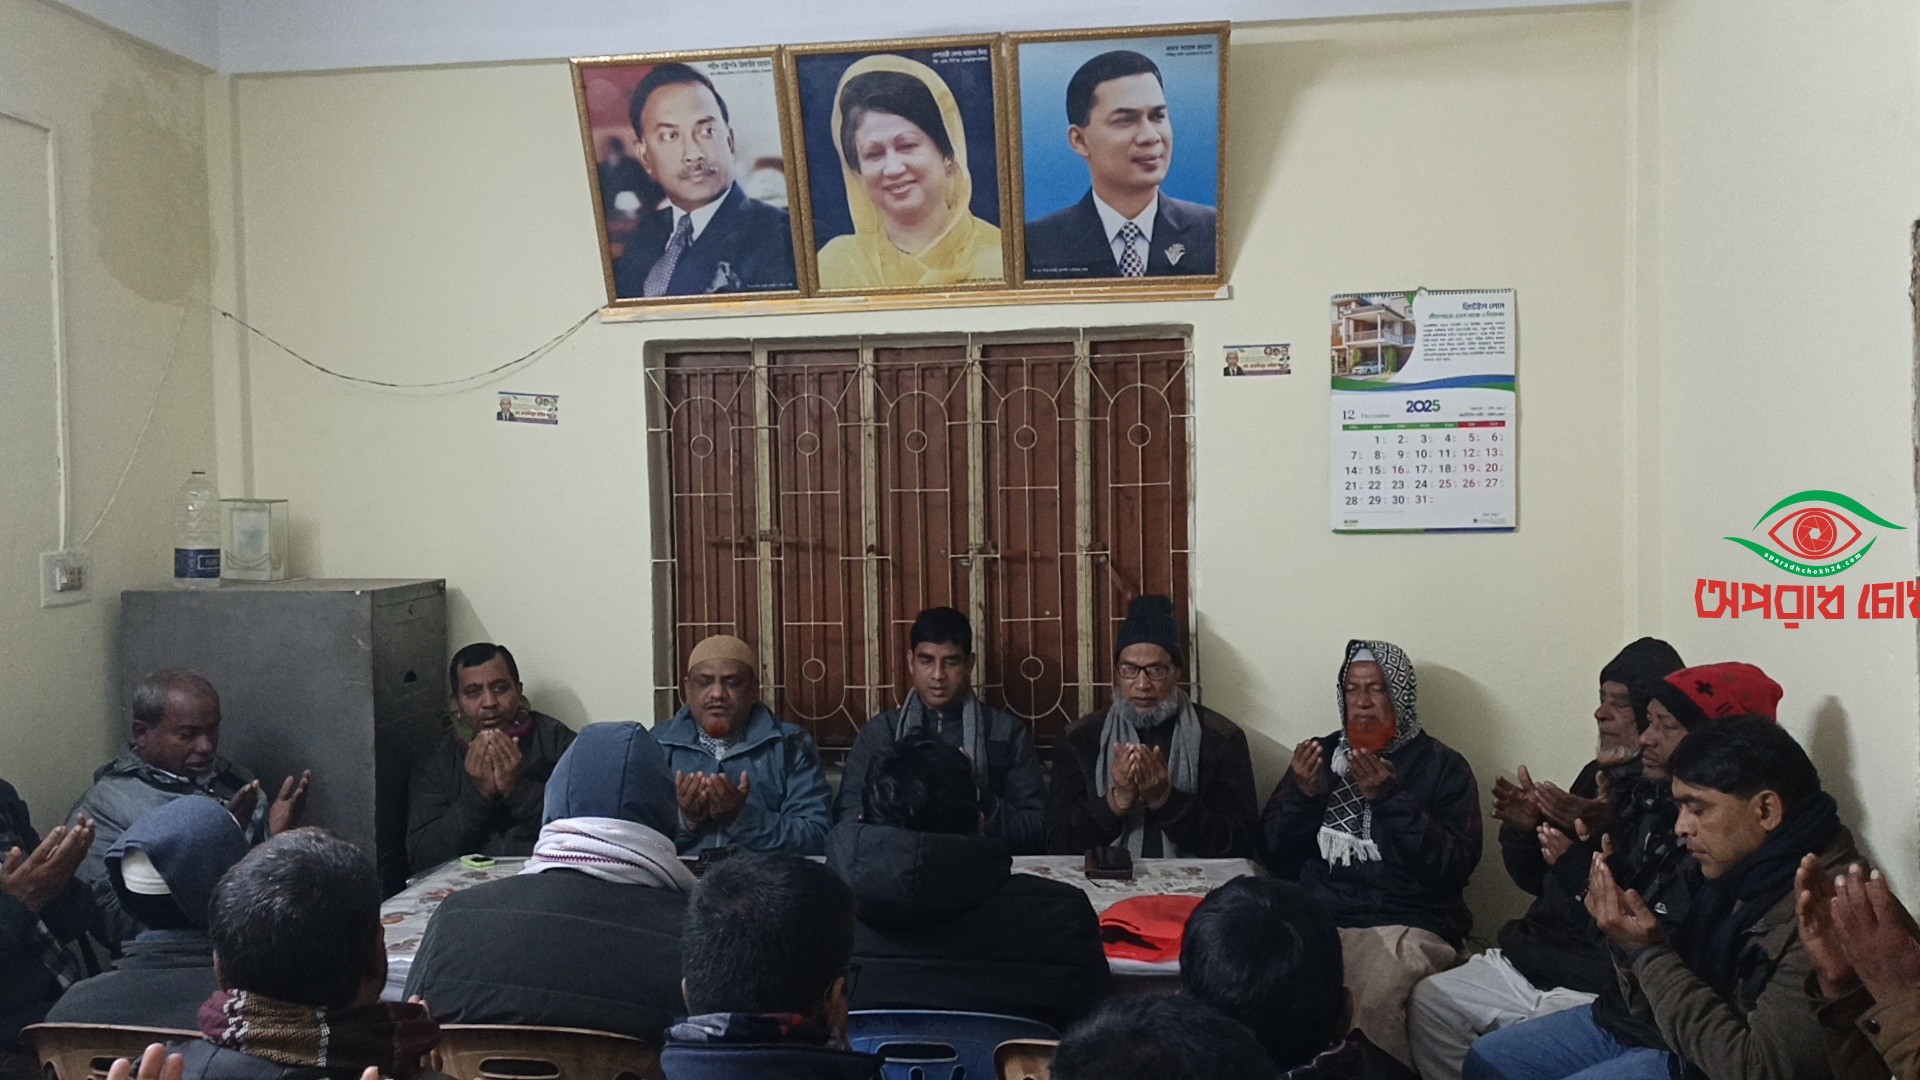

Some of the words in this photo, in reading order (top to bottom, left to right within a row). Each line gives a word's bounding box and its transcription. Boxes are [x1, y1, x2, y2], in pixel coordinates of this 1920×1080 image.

[1406, 400, 1441, 413] 2025
[1343, 410, 1355, 420] 12
[1375, 436, 1379, 444] 1
[1398, 435, 1403, 444] 2
[1421, 434, 1427, 443] 3
[1445, 434, 1450, 442] 4
[1469, 433, 1475, 442] 5
[1492, 433, 1498, 441] 6
[1352, 451, 1357, 459] 7
[1375, 451, 1380, 459] 8
[1398, 450, 1404, 458] 9
[1416, 450, 1427, 458] 10
[1440, 449, 1449, 457] 11
[1463, 448, 1475, 457] 12
[1486, 448, 1497, 457] 13
[1346, 467, 1357, 475] 14
[1369, 466, 1381, 475] 15
[1393, 466, 1404, 474] 16
[1416, 465, 1427, 473] 17
[1440, 464, 1451, 473] 18
[1464, 464, 1475, 472] 19
[1486, 463, 1498, 472] 20
[1346, 481, 1356, 490] 21
[1369, 481, 1380, 489] 22
[1392, 480, 1404, 489] 23
[1415, 480, 1427, 488] 24
[1439, 479, 1451, 488] 25
[1463, 479, 1475, 488] 26
[1486, 478, 1498, 487] 27
[1346, 496, 1358, 505] 28
[1369, 496, 1381, 505] 29
[1393, 496, 1404, 504] 30
[1416, 495, 1426, 504] 31
